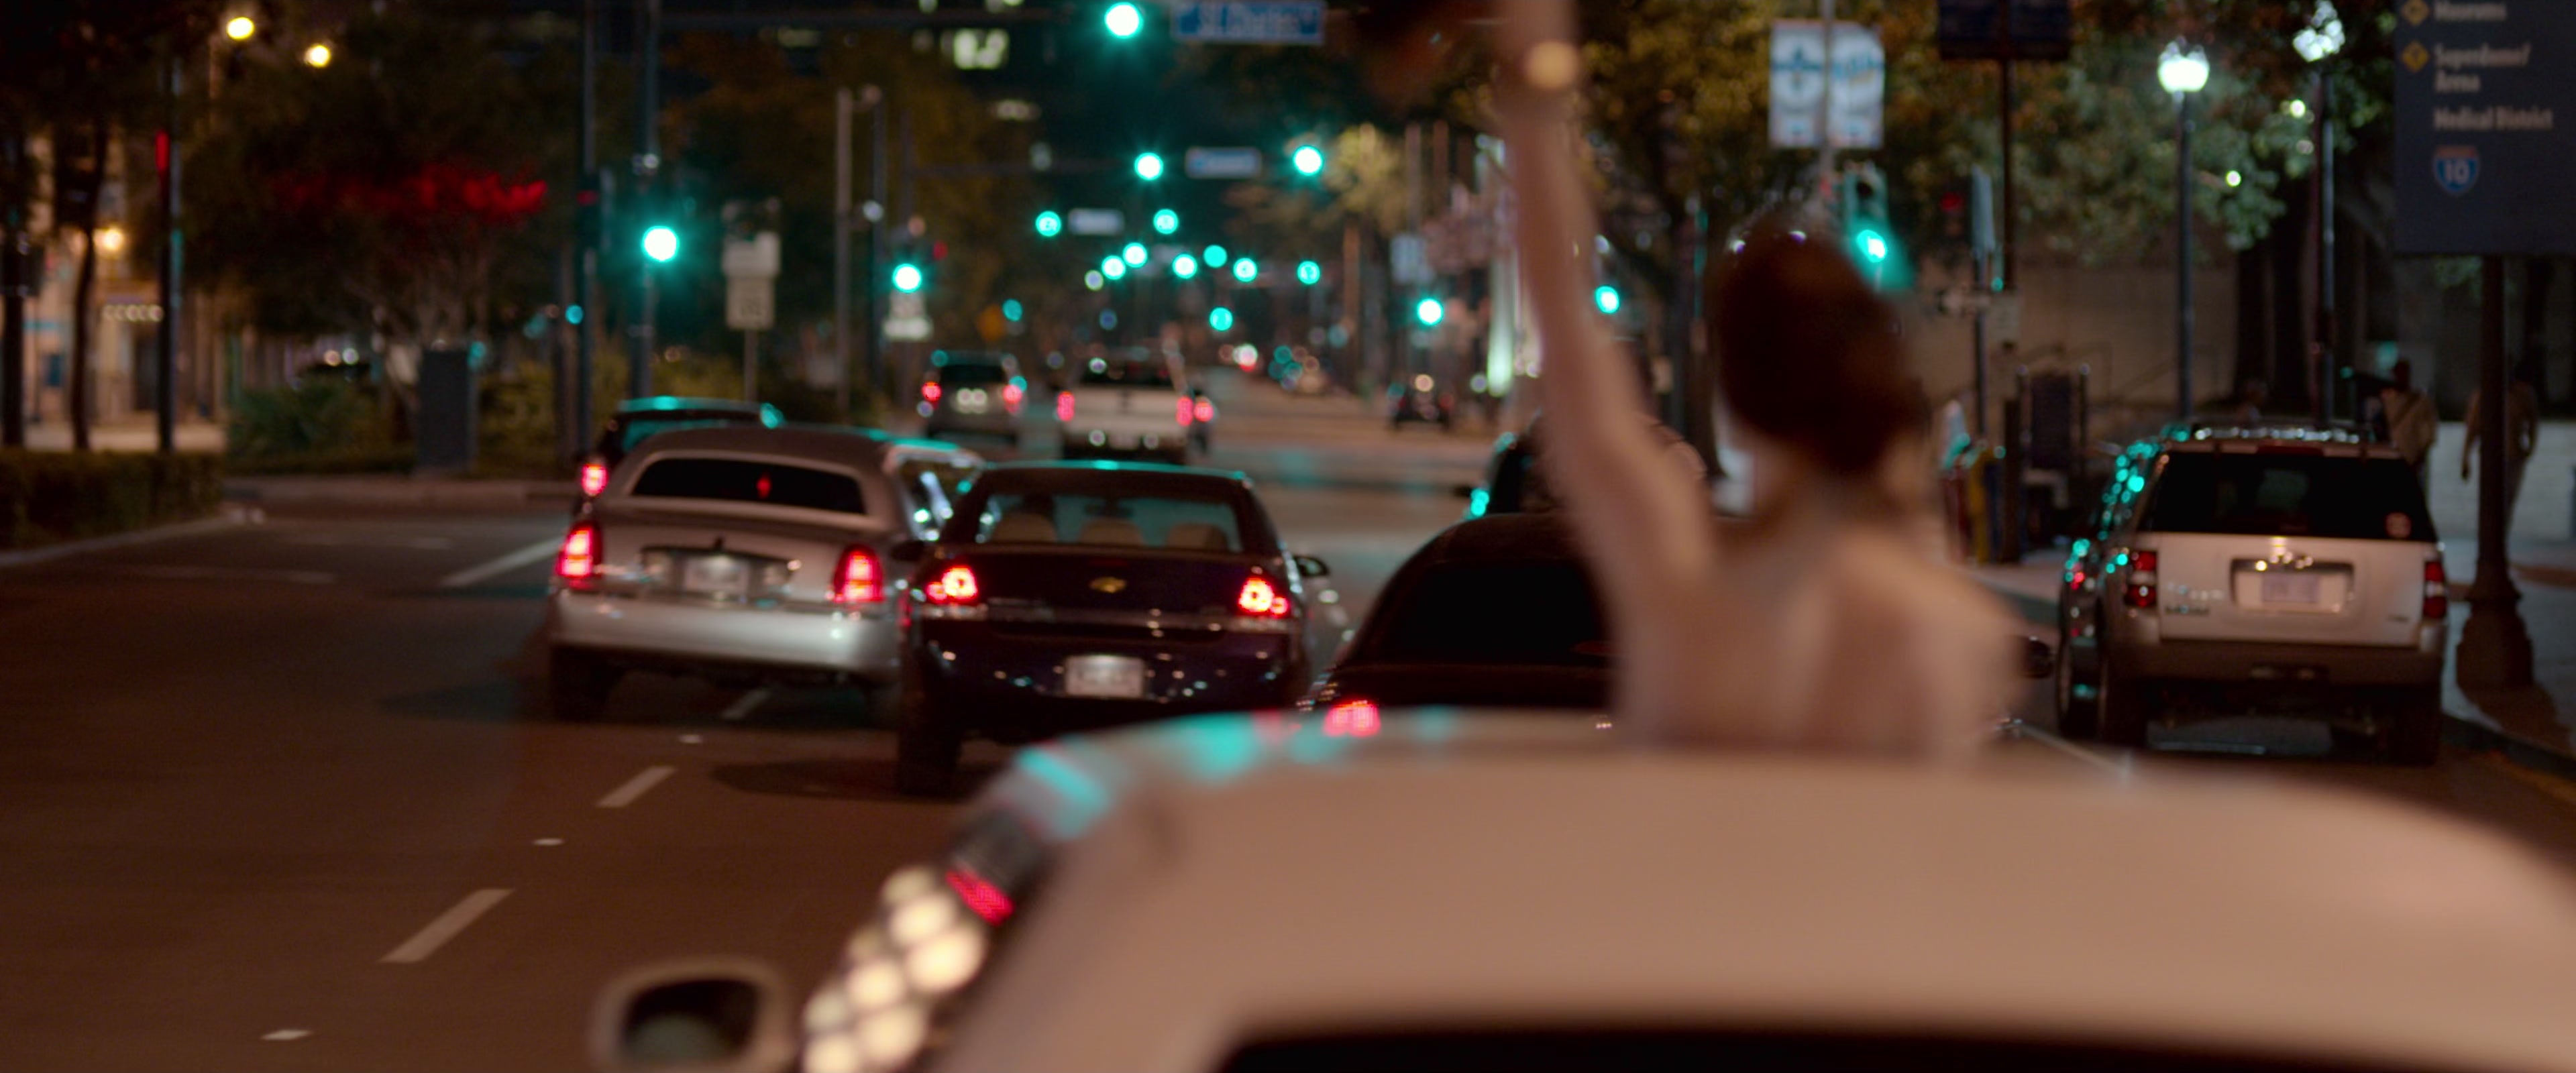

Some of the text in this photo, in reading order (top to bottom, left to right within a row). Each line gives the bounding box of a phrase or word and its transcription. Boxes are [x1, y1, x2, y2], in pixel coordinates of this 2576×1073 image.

[2434, 107, 2553, 129] Medical District
[2445, 160, 2471, 184] 10
